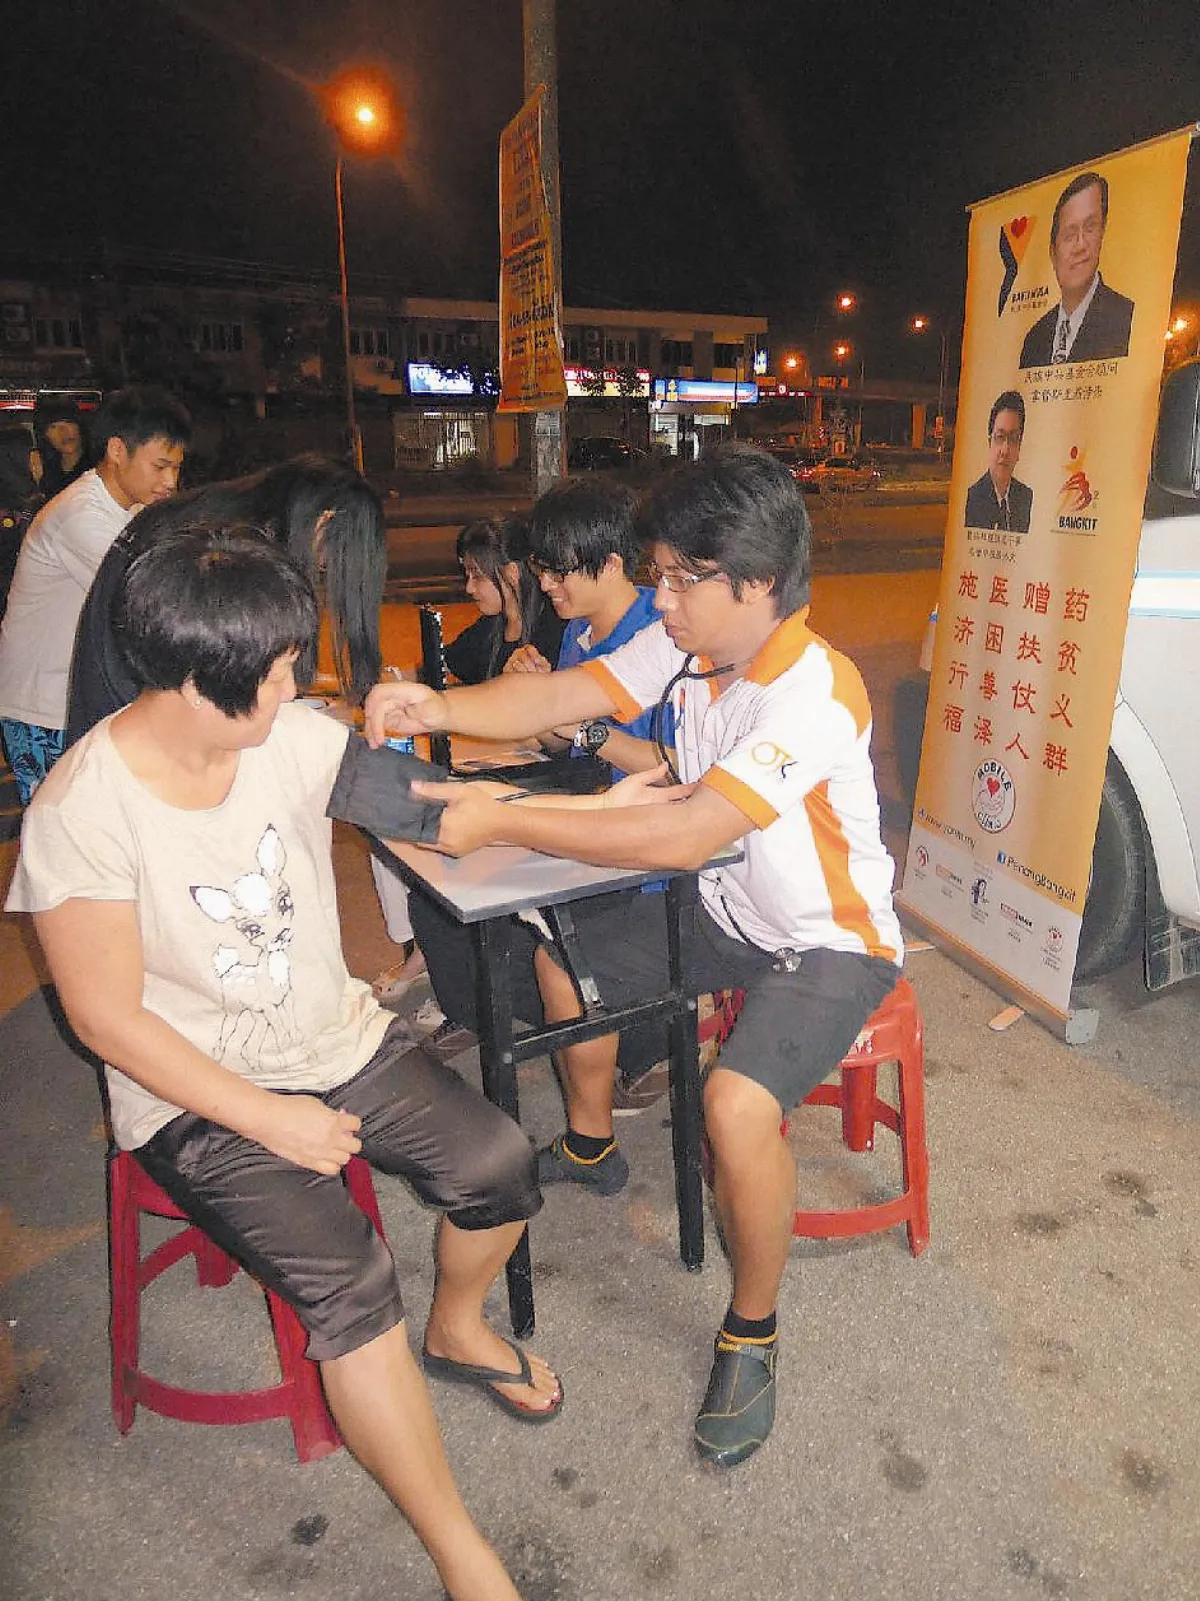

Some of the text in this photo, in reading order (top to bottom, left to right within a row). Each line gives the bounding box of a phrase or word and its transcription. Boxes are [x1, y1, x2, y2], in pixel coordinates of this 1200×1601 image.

[1059, 516, 1098, 530] BANGKIT
[958, 570, 1090, 622] 施医赠药
[953, 615, 1081, 675] 济困扶贫
[948, 660, 1073, 729] 行善仗义
[943, 703, 1068, 777] 福泽人群
[978, 762, 1012, 791] MOBILE
